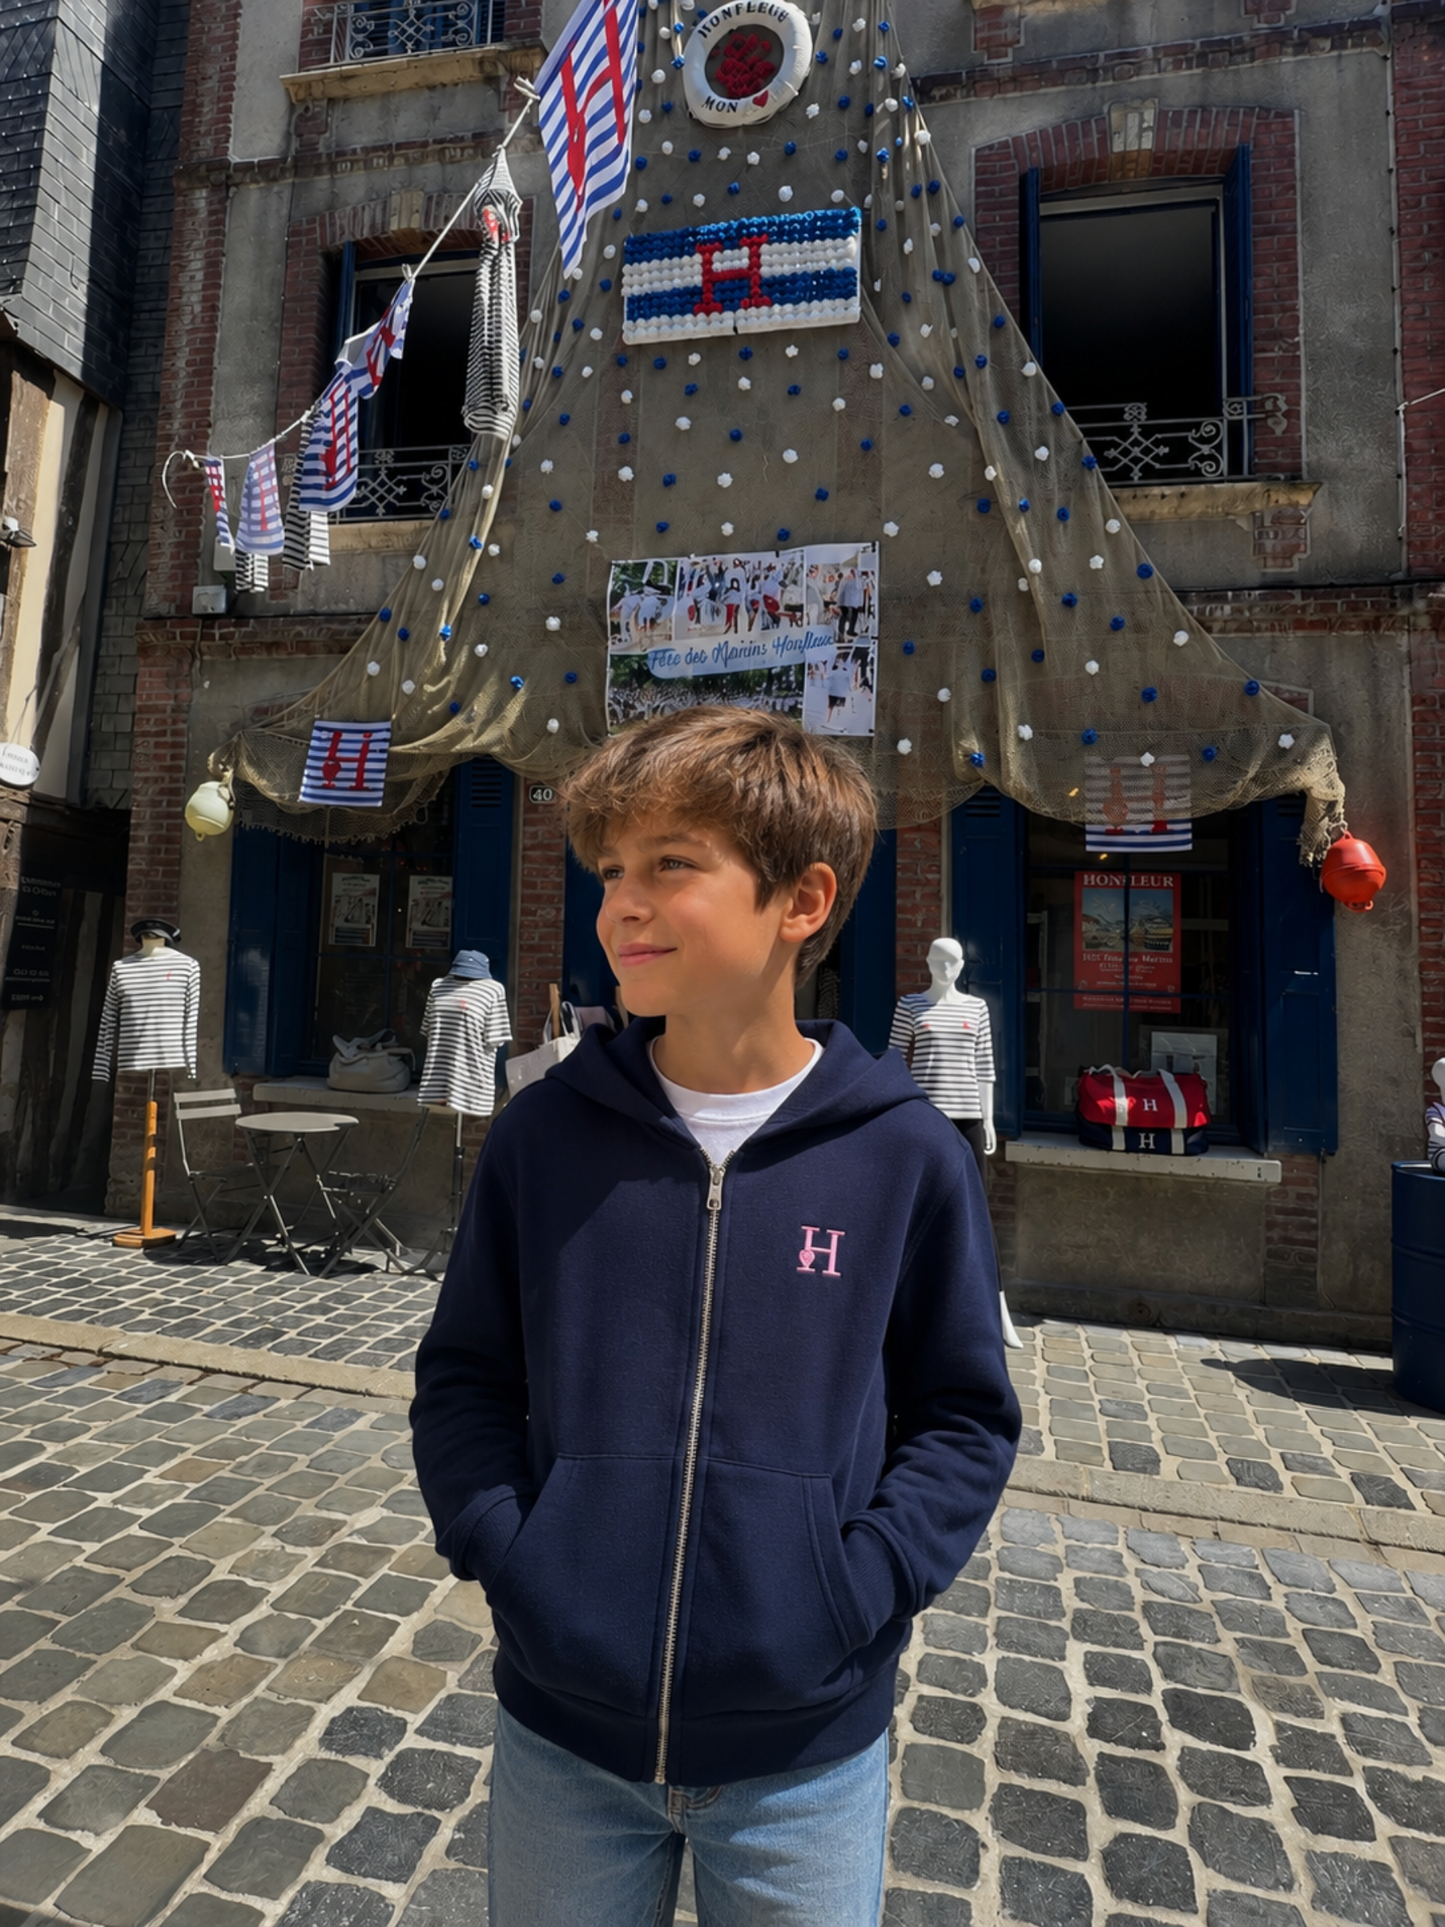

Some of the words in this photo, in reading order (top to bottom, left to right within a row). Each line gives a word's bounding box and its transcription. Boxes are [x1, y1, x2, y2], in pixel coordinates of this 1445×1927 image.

[702, 96, 739, 113] MON
[694, 234, 772, 315] H
[533, 788, 553, 801] 40
[1143, 1098, 1158, 1112] H
[1139, 1133, 1156, 1149] H
[796, 1225, 846, 1277] H
